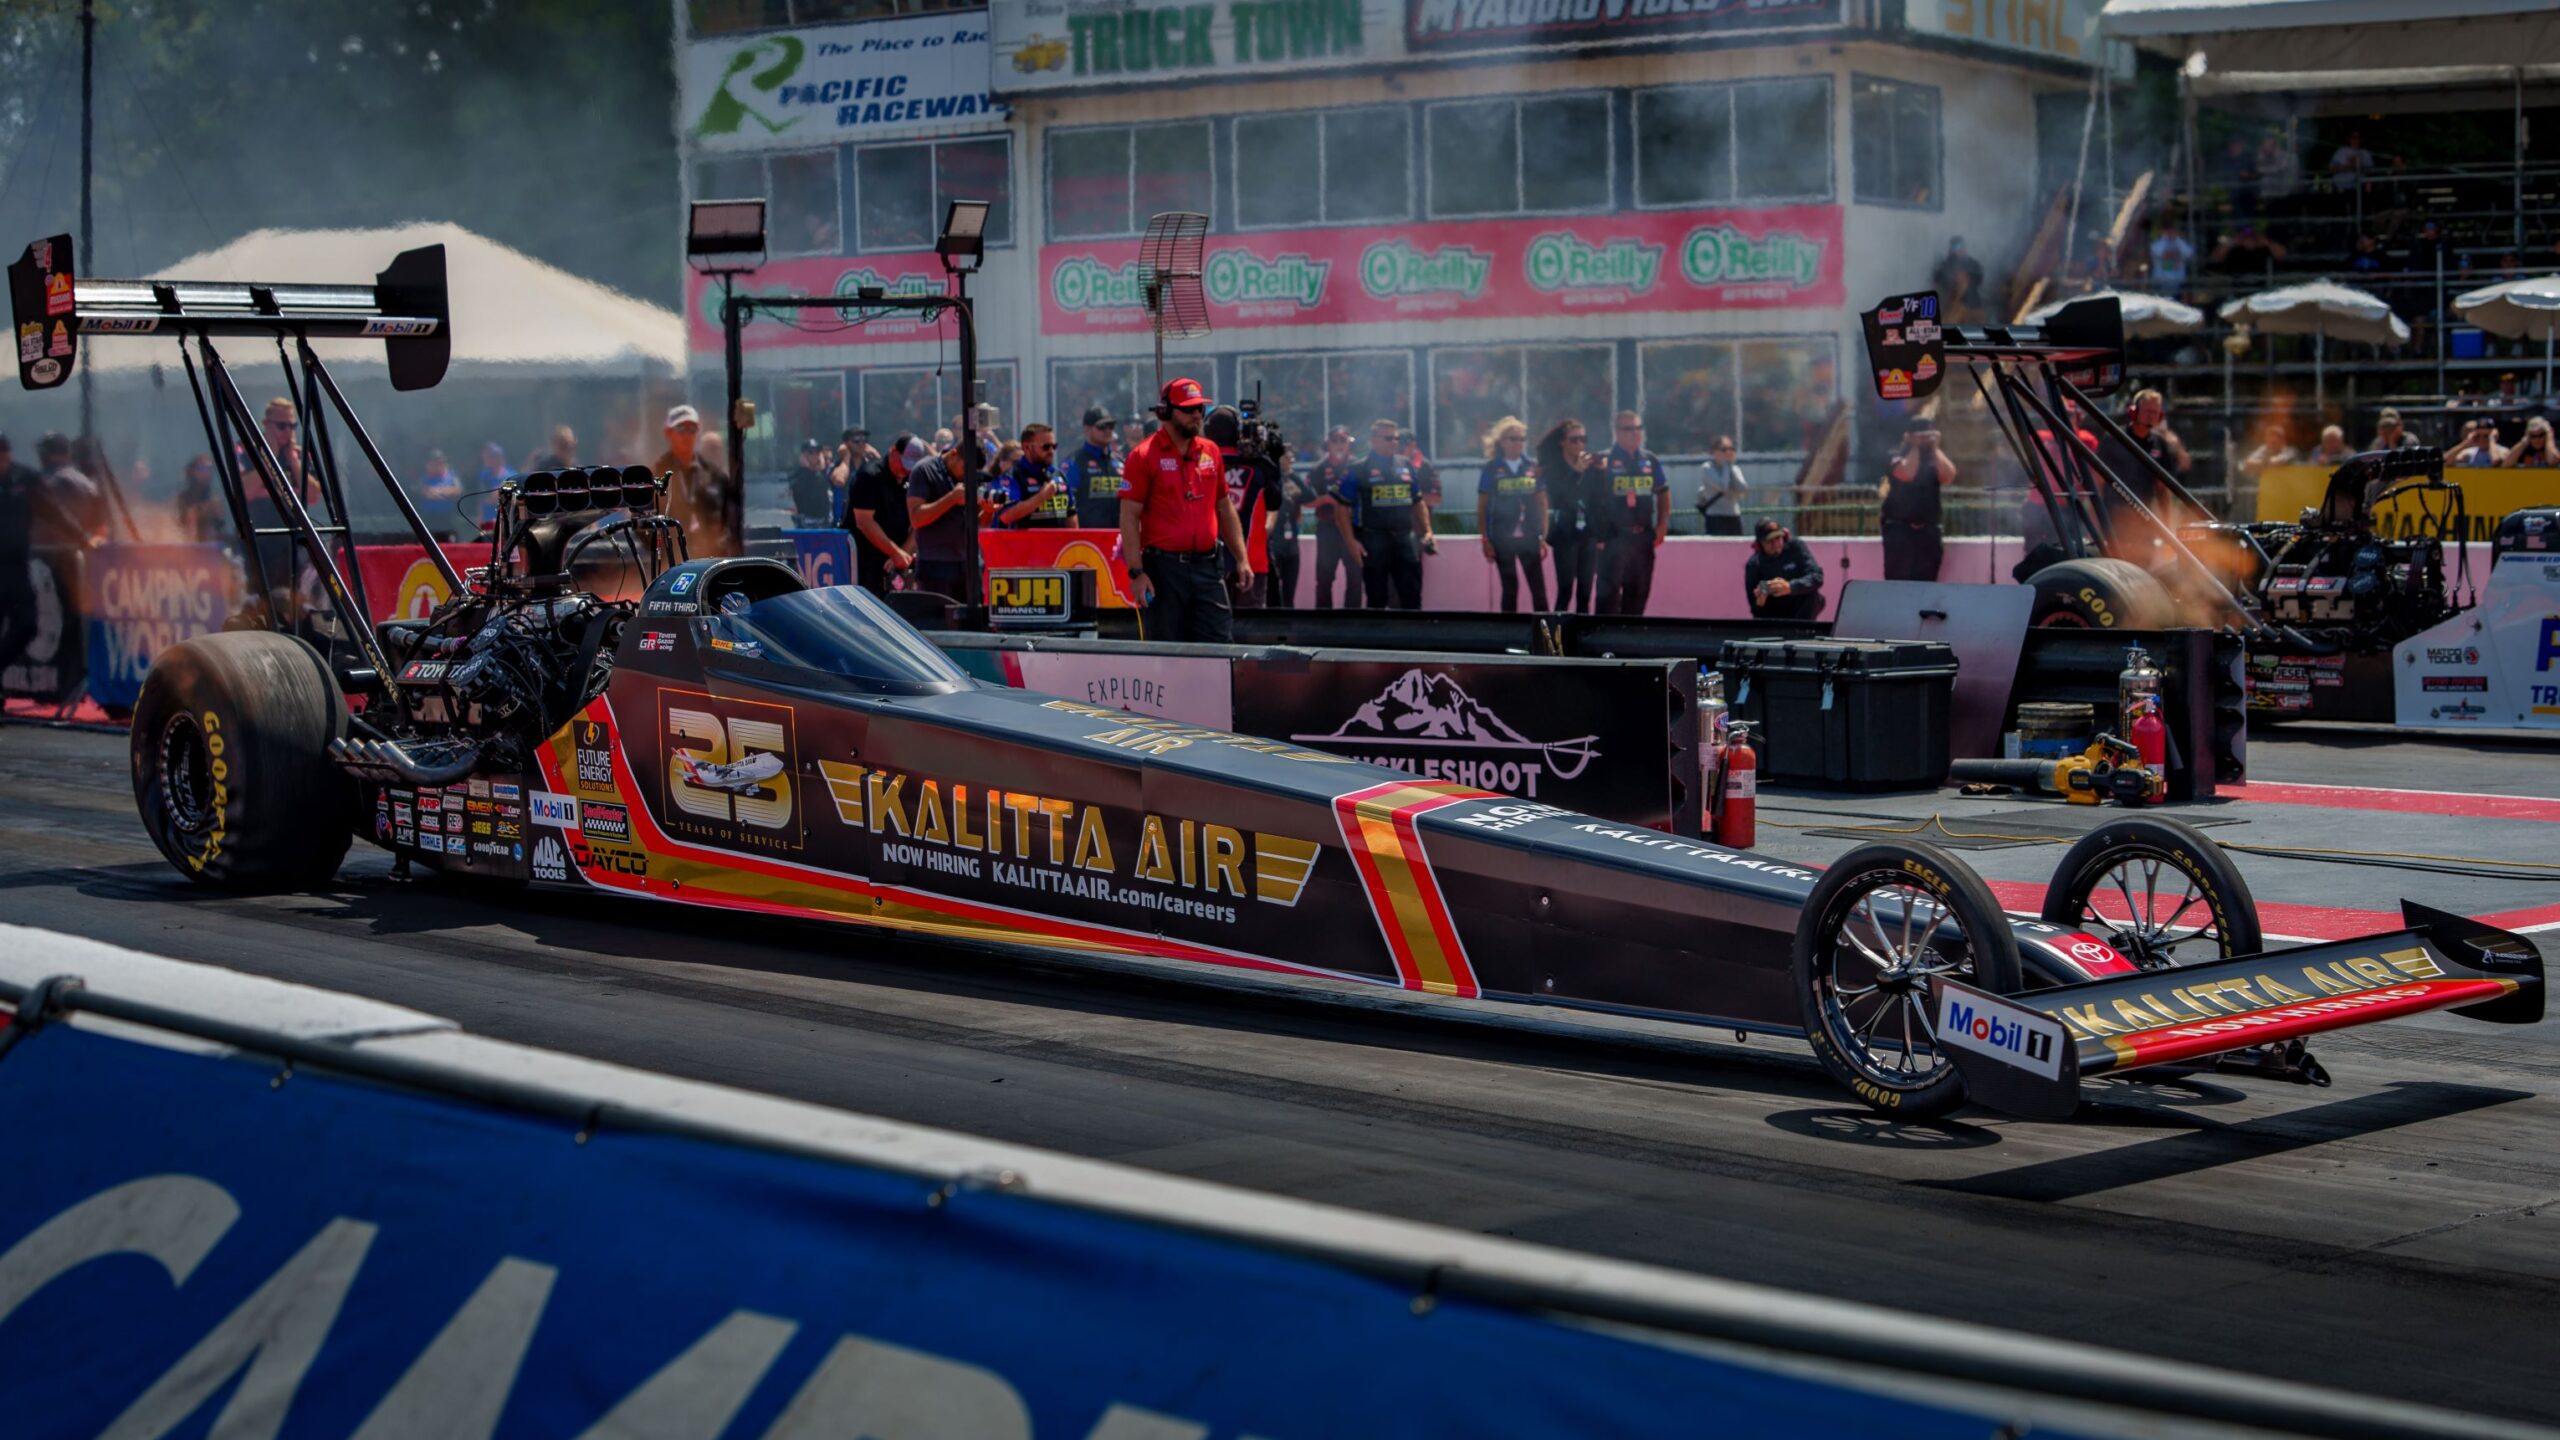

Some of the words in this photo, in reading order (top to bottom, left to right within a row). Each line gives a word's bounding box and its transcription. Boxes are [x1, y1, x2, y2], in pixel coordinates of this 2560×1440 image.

[863, 39, 913, 51] Place
[922, 36, 943, 48] to
[952, 30, 988, 44] Rac
[1067, 5, 1215, 77] TRUCK
[1231, 0, 1363, 63] TOWN
[779, 76, 907, 104] PACIFIC
[1369, 243, 1486, 290] O'Reilly
[1532, 240, 1653, 286] O'Reilly
[1689, 232, 1817, 281] O'Reilly
[1211, 254, 1325, 301] O'Reilly
[1920, 296, 1938, 319] 10
[86, 319, 133, 330] Mobil
[369, 323, 414, 333] Mobil
[1088, 476, 1121, 492] REE
[1614, 476, 1654, 489] REED
[103, 567, 212, 622] CAMPING
[991, 577, 1063, 607] PJH
[649, 600, 671, 612] FIFTH
[673, 602, 698, 613] THIRD
[998, 606, 1047, 615] BRANDS
[104, 619, 209, 683] WOR
[639, 639, 656, 650] GR
[2427, 648, 2462, 656] MATCO
[2275, 667, 2306, 678] JESEL
[2428, 655, 2462, 664] TOOLS
[1088, 677, 1165, 708] EXPLORE
[1084, 727, 1194, 756] AIR
[577, 749, 611, 768] FUTURE
[669, 707, 793, 830] 25
[579, 767, 612, 784] ENERGY
[580, 780, 614, 793] SOLUTIONS
[1345, 752, 1541, 798] CKLESHOOT
[419, 799, 440, 810] ARP
[533, 799, 563, 819] Mobil
[564, 803, 575, 822] 1
[420, 815, 440, 827] JESEL
[472, 820, 492, 835] JEGS
[868, 770, 1116, 874] KALITTA
[1135, 814, 1247, 898] AIR
[472, 841, 509, 856] GOODYEAR
[679, 822, 714, 836] YEARS
[720, 829, 732, 838] OF
[740, 833, 789, 850] SERVICE
[533, 836, 566, 869] MAC
[574, 843, 648, 877] DAYCO
[533, 867, 567, 881] TOOLS
[883, 842, 925, 866] NOW
[926, 851, 981, 878] HIRING
[993, 861, 1237, 924] KALITTAAIR.com/careers
[1903, 858, 1951, 894] EAGLE
[2062, 972, 2315, 1038] KALITTA
[2302, 955, 2401, 996] AIR
[2168, 1012, 2272, 1038] NOW
[2284, 984, 2434, 1018] HIRING
[1949, 1002, 2022, 1053] Mobil
[2030, 1030, 2050, 1059] 1
